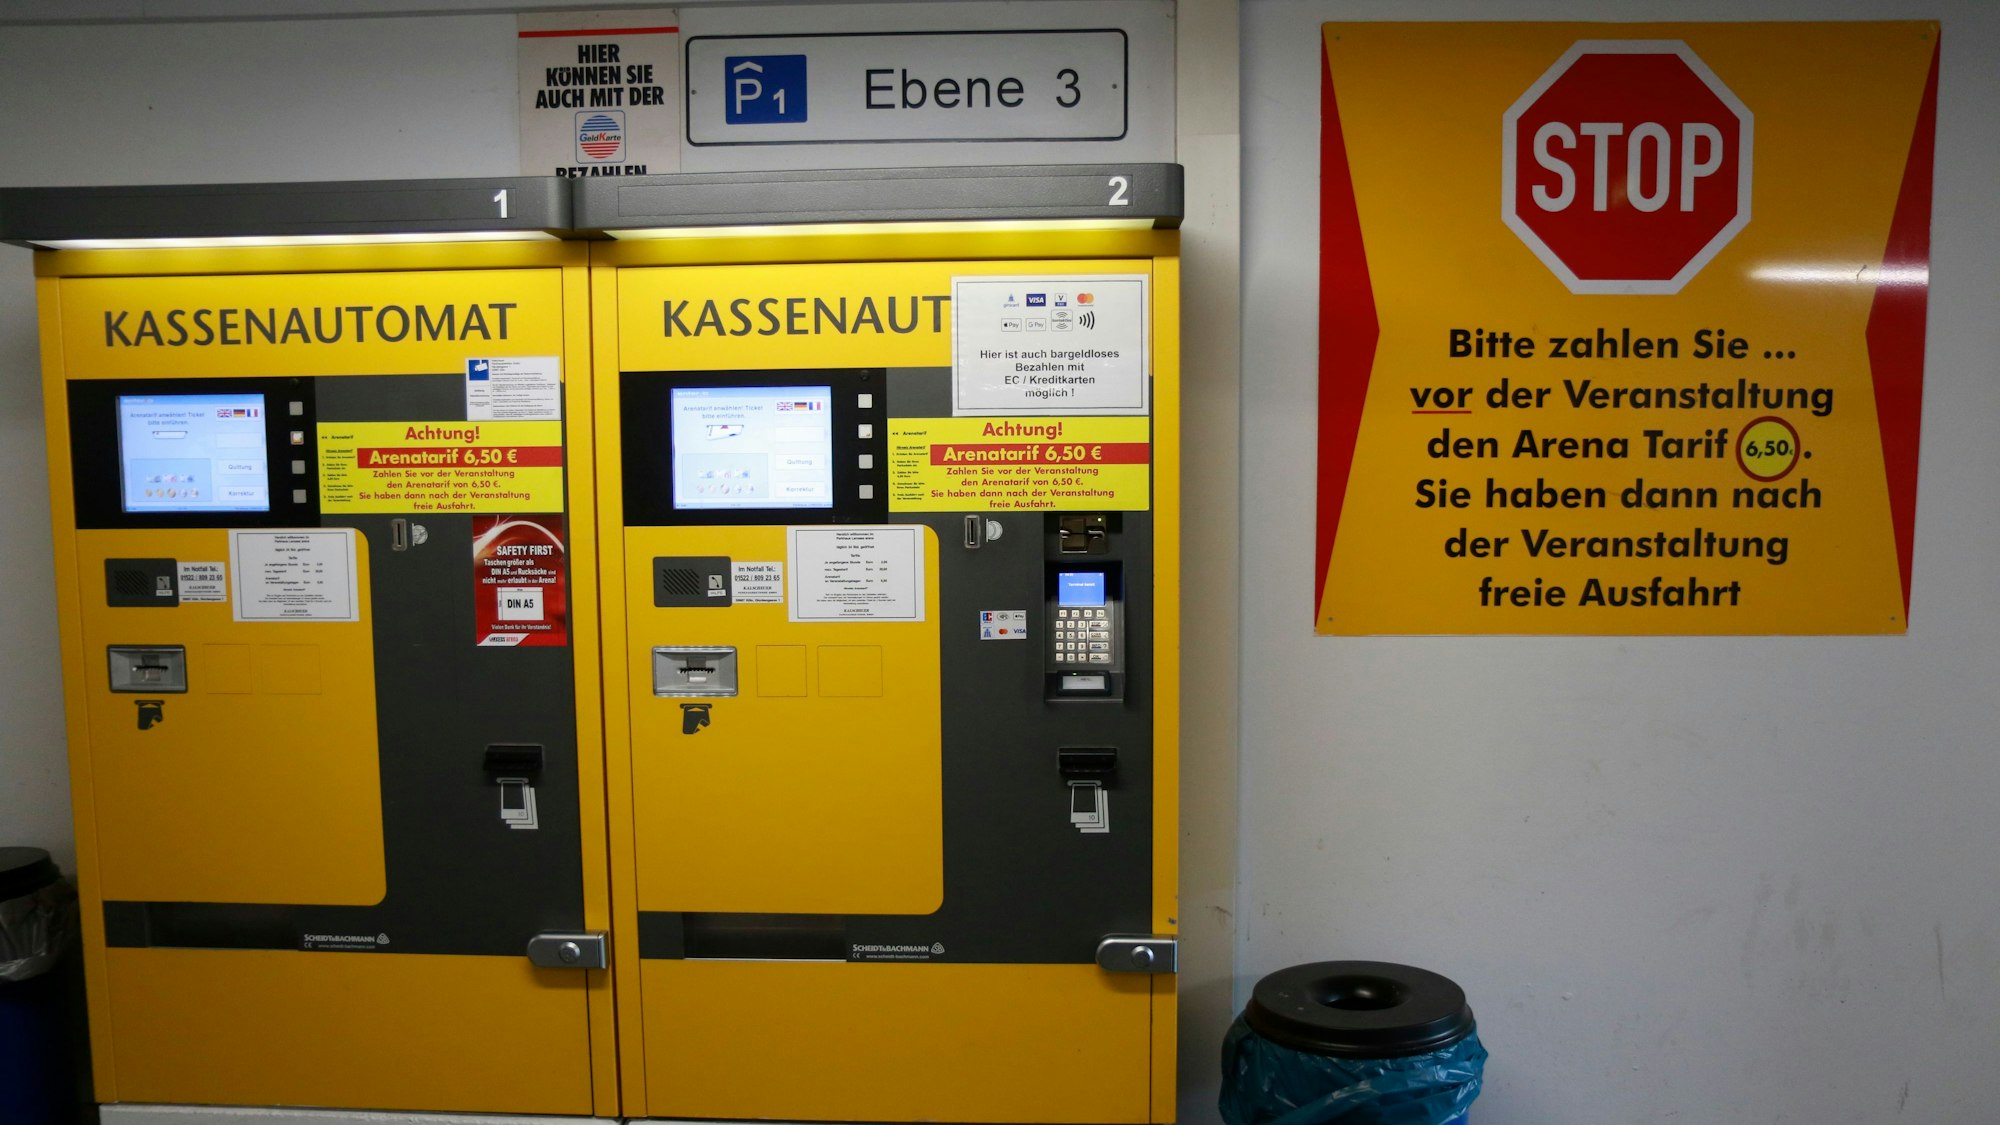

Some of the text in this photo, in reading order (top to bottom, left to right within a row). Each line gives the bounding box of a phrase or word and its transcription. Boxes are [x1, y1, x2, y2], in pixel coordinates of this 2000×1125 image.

[578, 44, 620, 63] HIER
[546, 65, 653, 86] KÖNNEN SIE
[536, 86, 664, 109] AUCH MIT DER
[734, 68, 1082, 115] P 1 Ebene 3
[580, 132, 621, 142] GeldKarte
[1531, 121, 1724, 213] STOP
[1108, 177, 1128, 205] 2
[493, 190, 508, 218] 1
[104, 302, 518, 347] KASSENAUTOMAT
[1448, 328, 1536, 359] Bitte
[1549, 328, 1679, 359] zahlen
[1693, 328, 1749, 359] Sie
[981, 350, 1119, 360] Hier ist auch bargeldloses
[1016, 363, 1084, 372] Bezahlen mit
[1005, 376, 1095, 384] EC / Kreditkarten
[1025, 388, 1067, 399] möglich
[1410, 378, 1834, 417] vor der Veranstaltung
[405, 426, 480, 443] Achtung!
[983, 422, 1062, 440] Achtung!
[1427, 428, 1498, 459] den
[1512, 428, 1629, 459] Arena
[1643, 428, 1728, 459] Tarif
[369, 449, 517, 466] Arenatarif 6,50 €
[943, 446, 1102, 462] Arenatarif 6,50 €
[455, 470, 514, 479] Veranstaltung
[946, 467, 978, 476] Zahlen
[1016, 467, 1031, 475] der
[1035, 467, 1099, 476] Veranstaltung
[472, 481, 488, 489] 6,50
[1053, 478, 1071, 487] 6,50
[470, 492, 530, 500] Veranstaltung
[931, 489, 1114, 498] Sie haben dann nach der Veranstaltung
[1414, 478, 1822, 509] Sie haben dann nach
[497, 546, 553, 555] SAFETY FIRST
[1444, 528, 1789, 567] der Veranstaltung
[1478, 576, 1741, 607] freie Ausfahrt
[508, 599, 521, 608] DIN
[524, 599, 533, 608] A5
